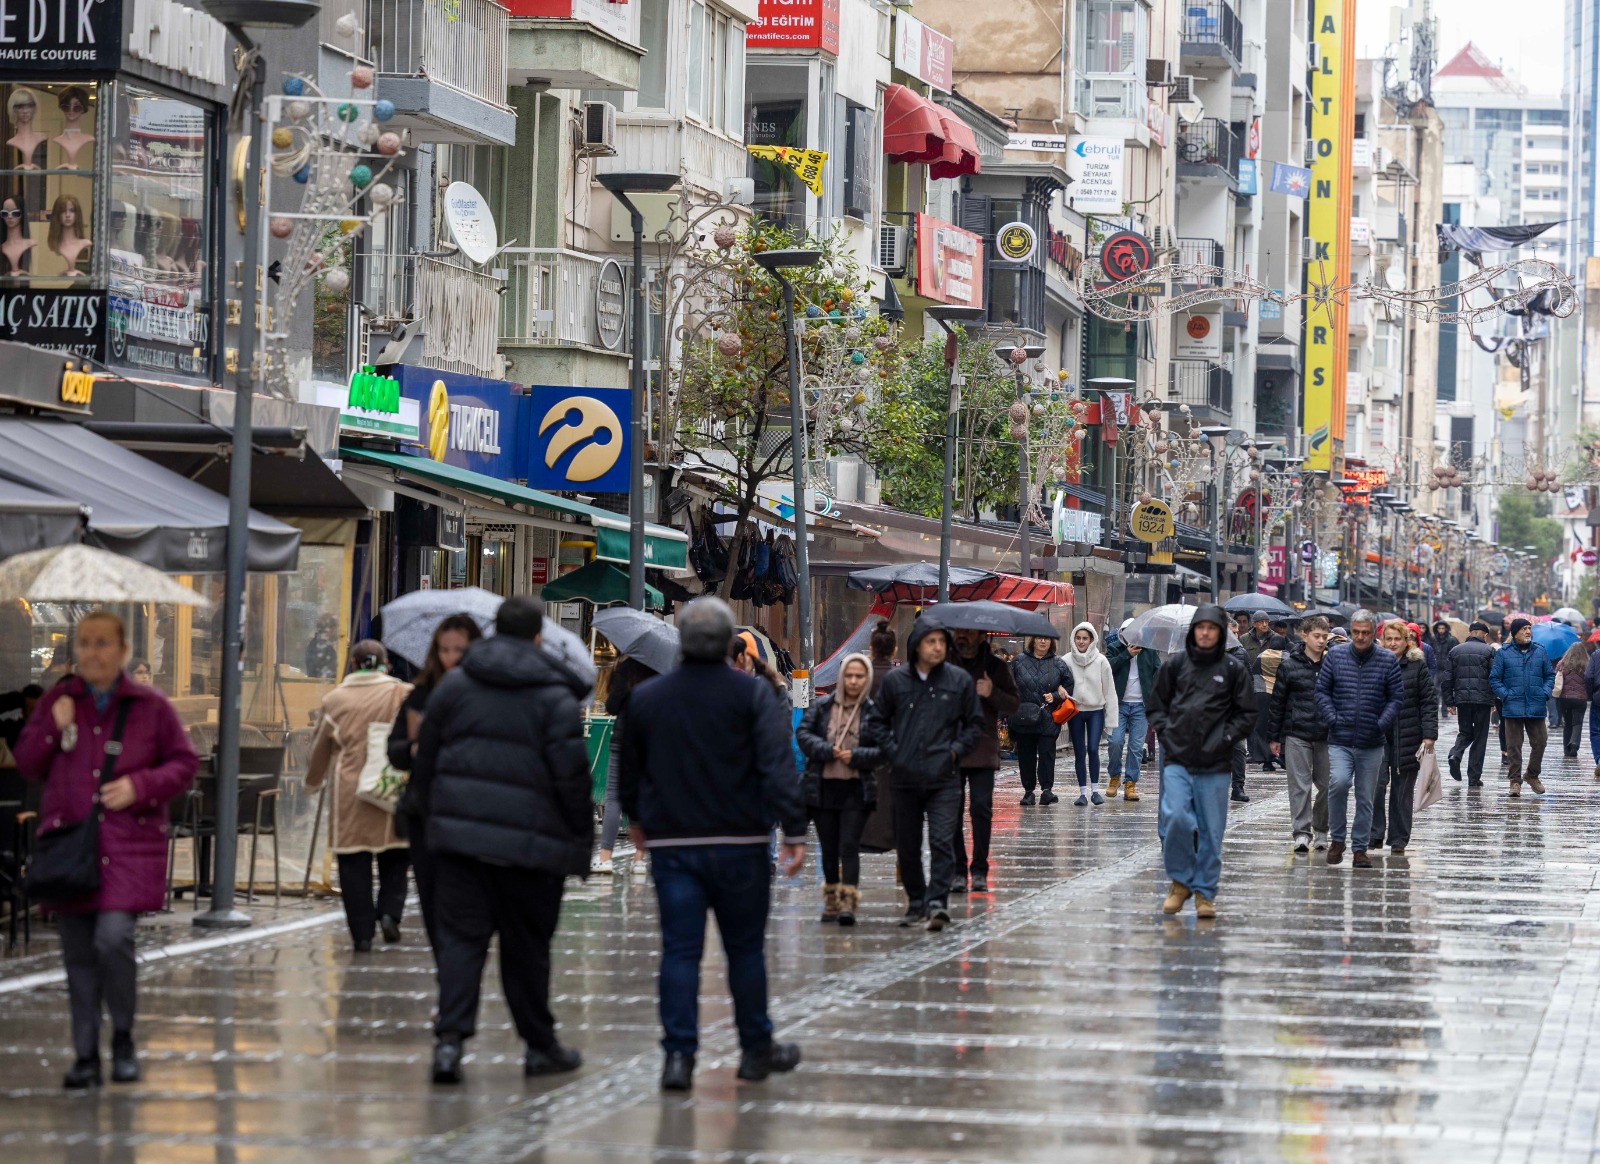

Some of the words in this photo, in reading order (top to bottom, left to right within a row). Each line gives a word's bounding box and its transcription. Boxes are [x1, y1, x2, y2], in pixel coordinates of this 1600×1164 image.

[771, 14, 815, 27] EĞİTİM
[0, 48, 37, 60] HAUTE
[40, 49, 97, 60] COUTURE
[1084, 144, 1121, 155] ebruli
[1086, 162, 1110, 170] TURİZM
[28, 295, 100, 336] SATIŞ
[450, 403, 501, 455] TURKCELL
[1140, 513, 1166, 523] Alsancak
[1138, 519, 1166, 535] 1924
